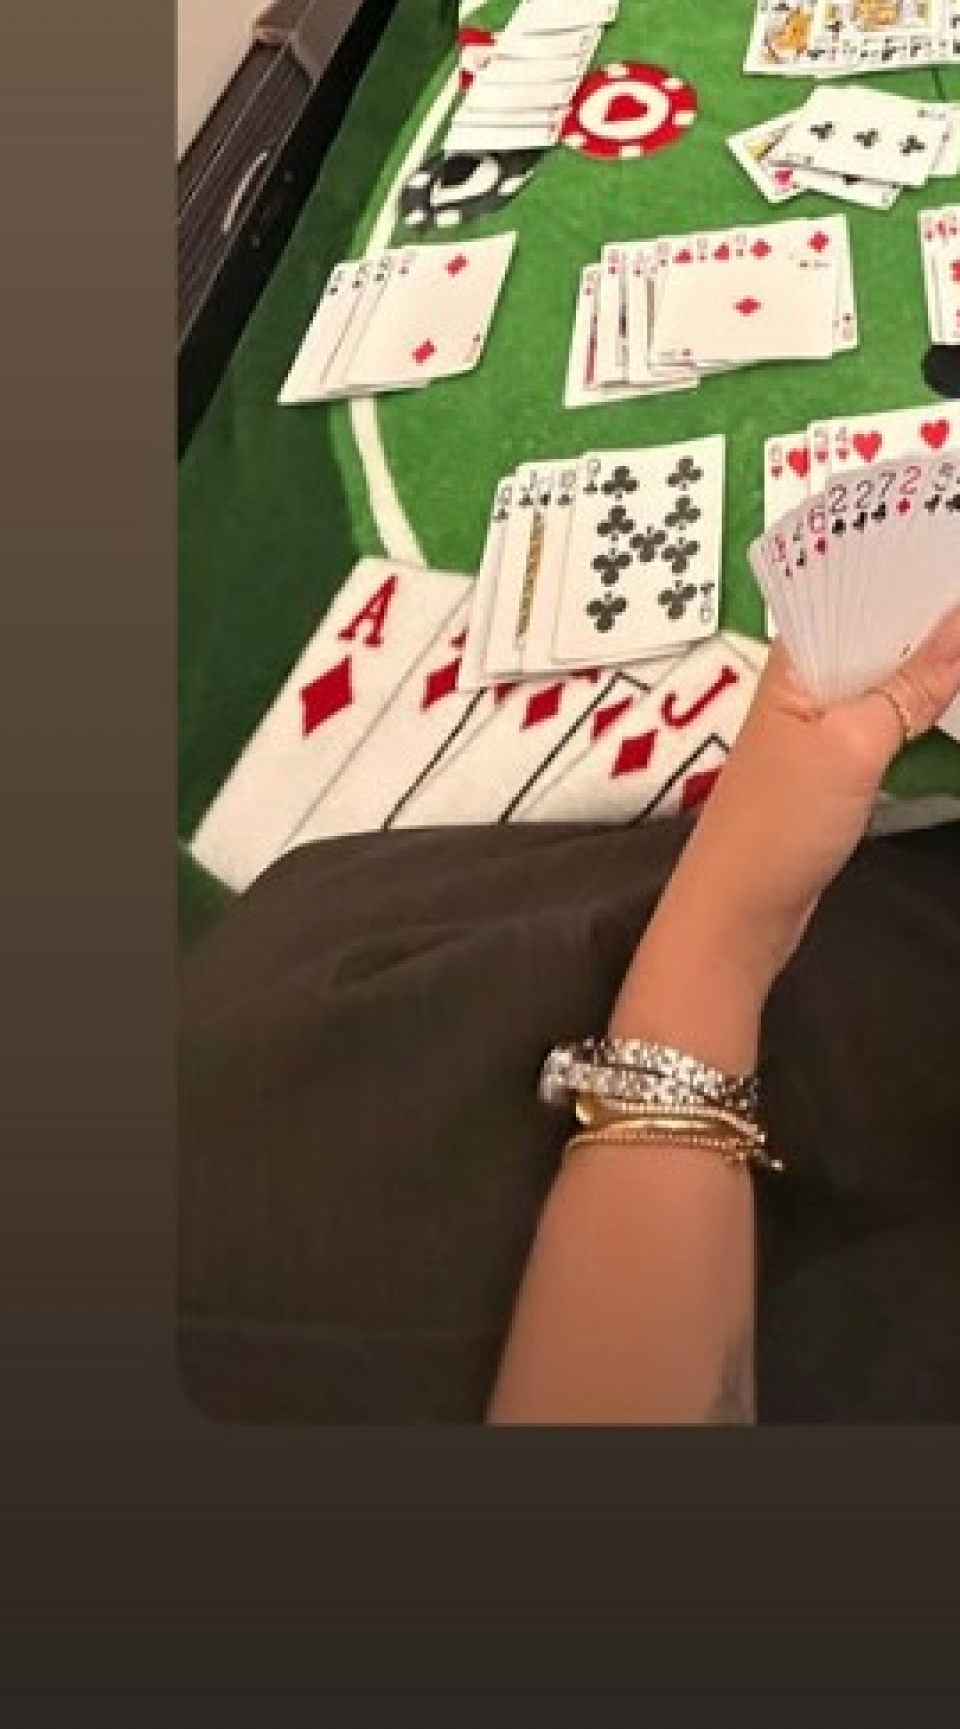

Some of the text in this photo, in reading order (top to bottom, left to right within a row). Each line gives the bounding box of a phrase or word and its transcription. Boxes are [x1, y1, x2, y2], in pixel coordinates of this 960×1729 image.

[853, 480, 876, 510] 2
[878, 471, 898, 500] 7
[900, 465, 923, 496] 2
[828, 484, 848, 514] 2
[336, 573, 399, 649] A
[660, 664, 740, 729] J
